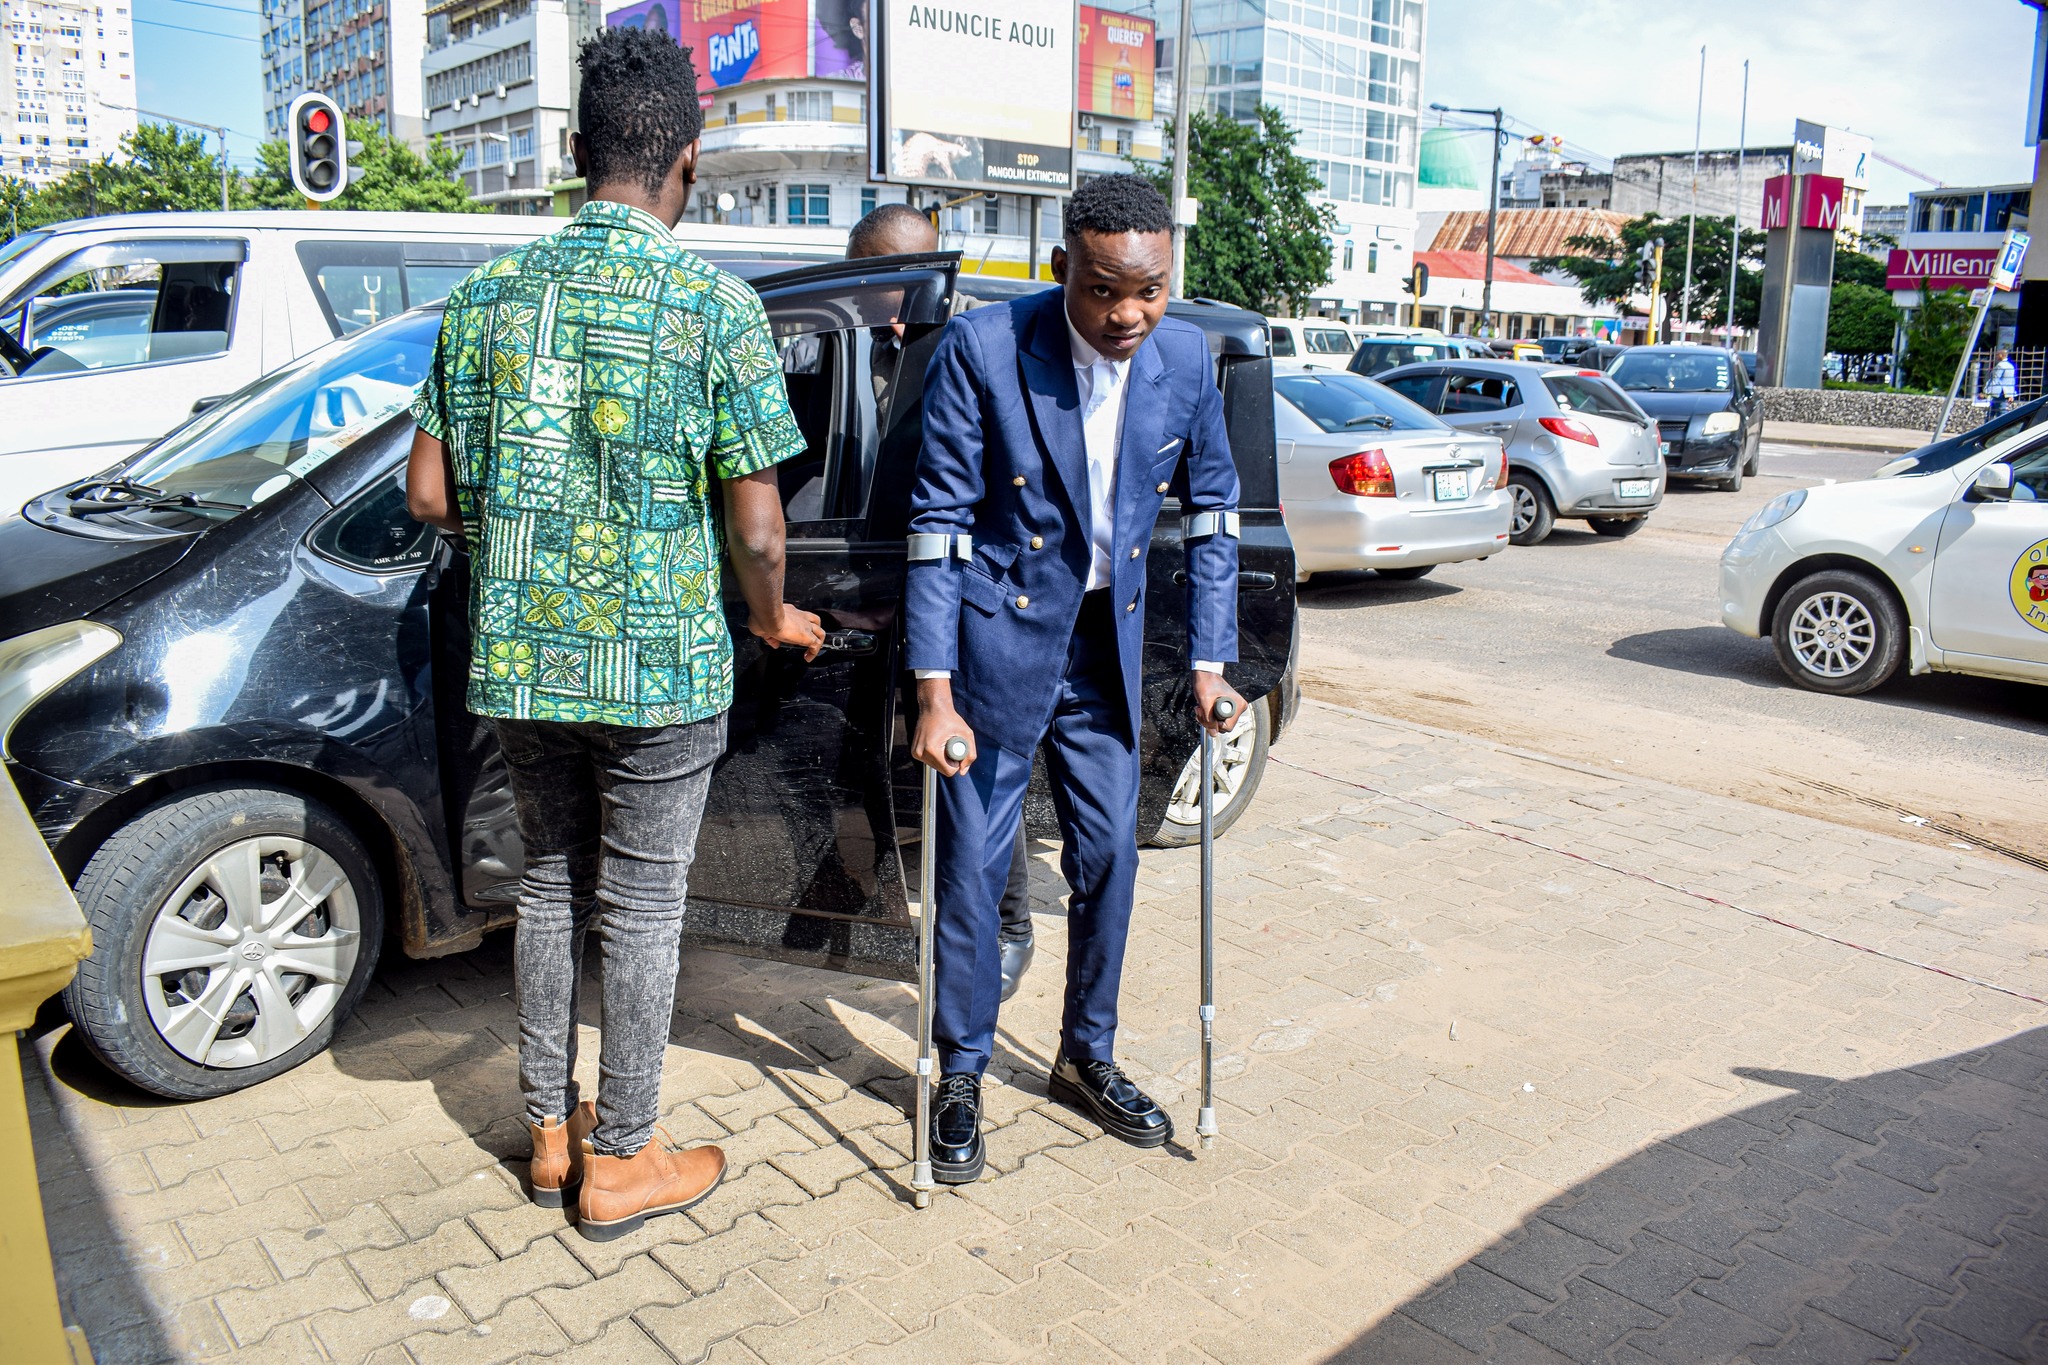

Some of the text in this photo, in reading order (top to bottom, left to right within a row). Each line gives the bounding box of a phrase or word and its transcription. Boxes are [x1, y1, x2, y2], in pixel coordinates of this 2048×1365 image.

[909, 5, 1054, 49] ANUNCIE AQUI
[1108, 26, 1144, 48] QUERES?
[709, 20, 759, 73] FANTA
[1017, 153, 1039, 167] STOP
[987, 165, 1069, 184] PANGOLIN EXTINCTION
[1818, 193, 1842, 231] M
[2005, 249, 2018, 270] P
[394, 553, 406, 561] 447
[410, 551, 422, 559] MP
